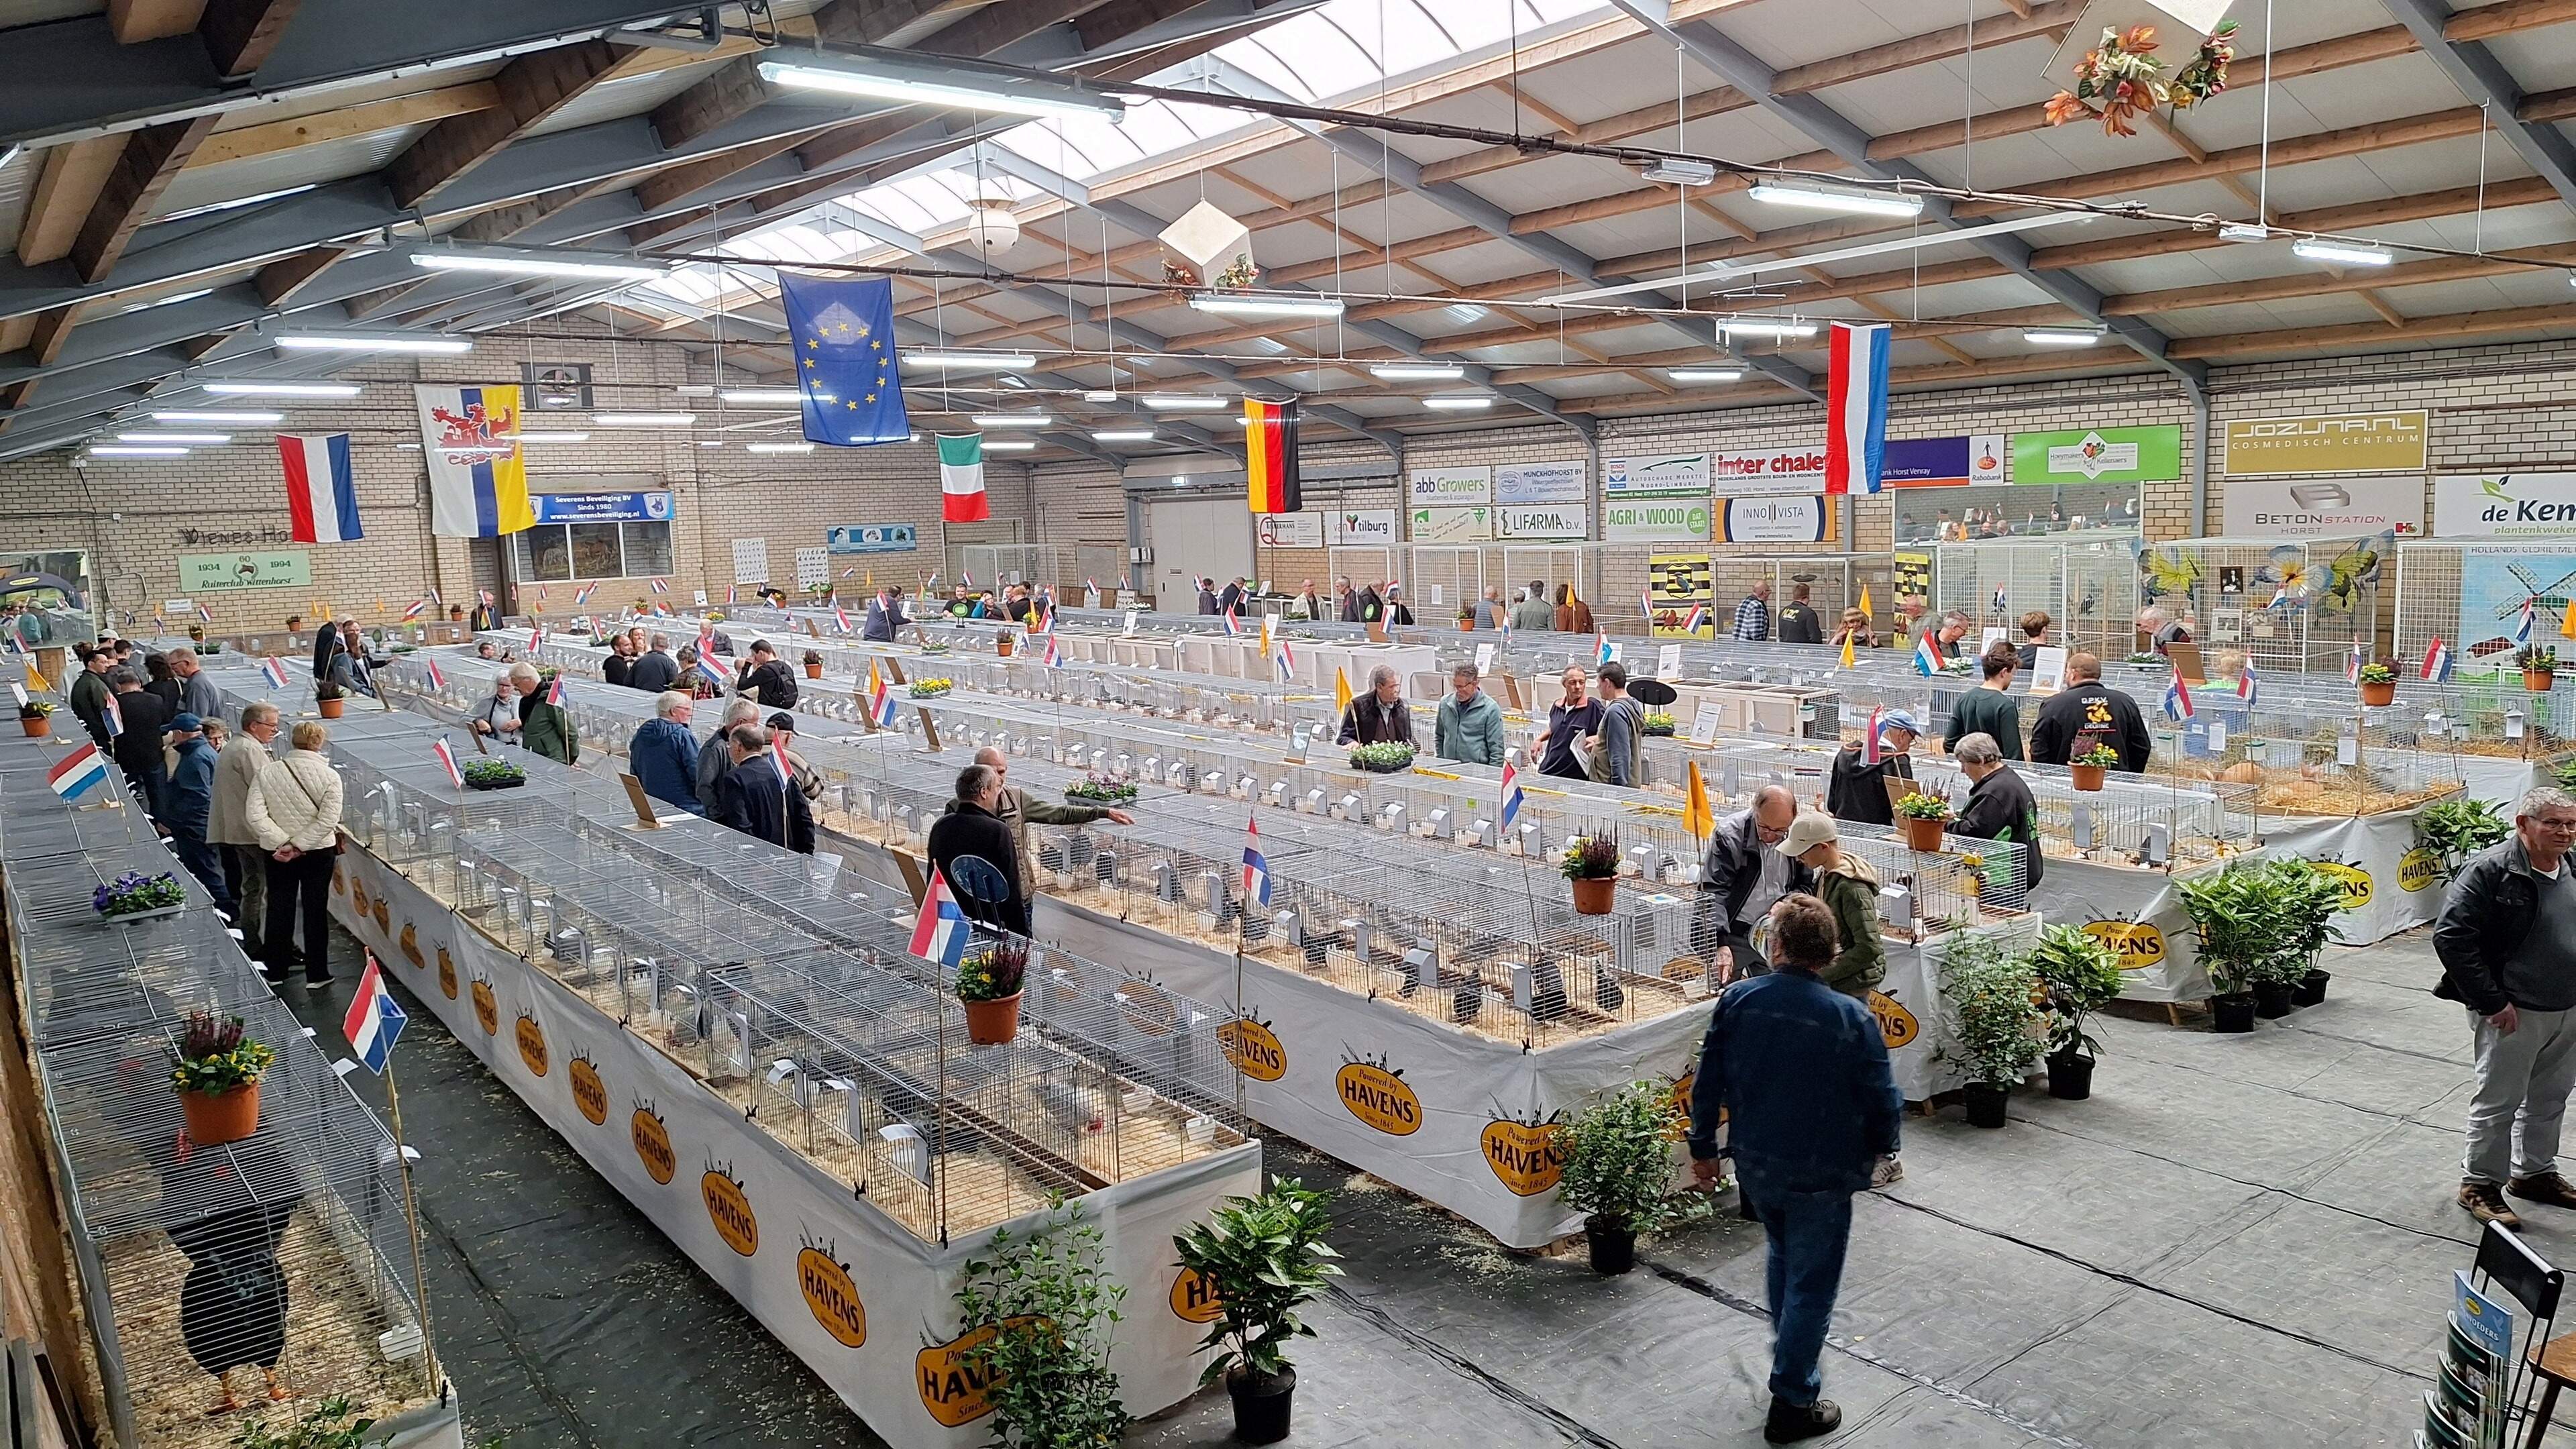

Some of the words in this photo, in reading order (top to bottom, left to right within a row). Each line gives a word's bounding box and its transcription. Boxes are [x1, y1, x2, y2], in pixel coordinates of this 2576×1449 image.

[2233, 438, 2331, 450] COSMEDISCH
[2343, 434, 2419, 445] CENTRUM
[1717, 454, 1766, 475] inter
[1909, 468, 1931, 476] Venray
[1523, 469, 1573, 478] MUNCKHOFHORST
[1972, 474, 2002, 482] Rabobank
[1415, 476, 1436, 494] abb
[1437, 476, 1485, 493] Growers
[586, 494, 621, 502] Beveiliging
[1608, 508, 1637, 525] AGRI
[1639, 513, 1644, 521] &
[1646, 508, 1685, 525] WOOD
[1692, 513, 1701, 521] DAT
[1778, 506, 1804, 518] VISTA
[2481, 504, 2509, 522] de
[1358, 520, 1388, 534] tilburg
[1513, 513, 1564, 531] LIFARMA
[1566, 519, 1582, 530] b.v.
[1689, 520, 1705, 529] STAAT!
[2281, 527, 2322, 535] HORST
[198, 564, 221, 572] 1934
[270, 560, 291, 568] 1994
[201, 580, 244, 589] Ruiterclub
[244, 576, 294, 586] Wittenhorst
[1878, 998, 1888, 1011] by
[1358, 1068, 1389, 1087] Powered
[1389, 1079, 1398, 1093] by
[573, 1071, 604, 1113] HAVENS
[1344, 1076, 1414, 1124] HAVENS
[1363, 1110, 1380, 1126] Since
[1380, 1118, 1395, 1131] 1845
[1507, 1126, 1542, 1146] Powered
[635, 1123, 671, 1171] HAVENS
[1528, 1177, 1549, 1190] 1845
[707, 1187, 753, 1243] HAVENS
[814, 1255, 839, 1282] Powered
[804, 1264, 860, 1335] HAVENS
[957, 1400, 984, 1418] Since
